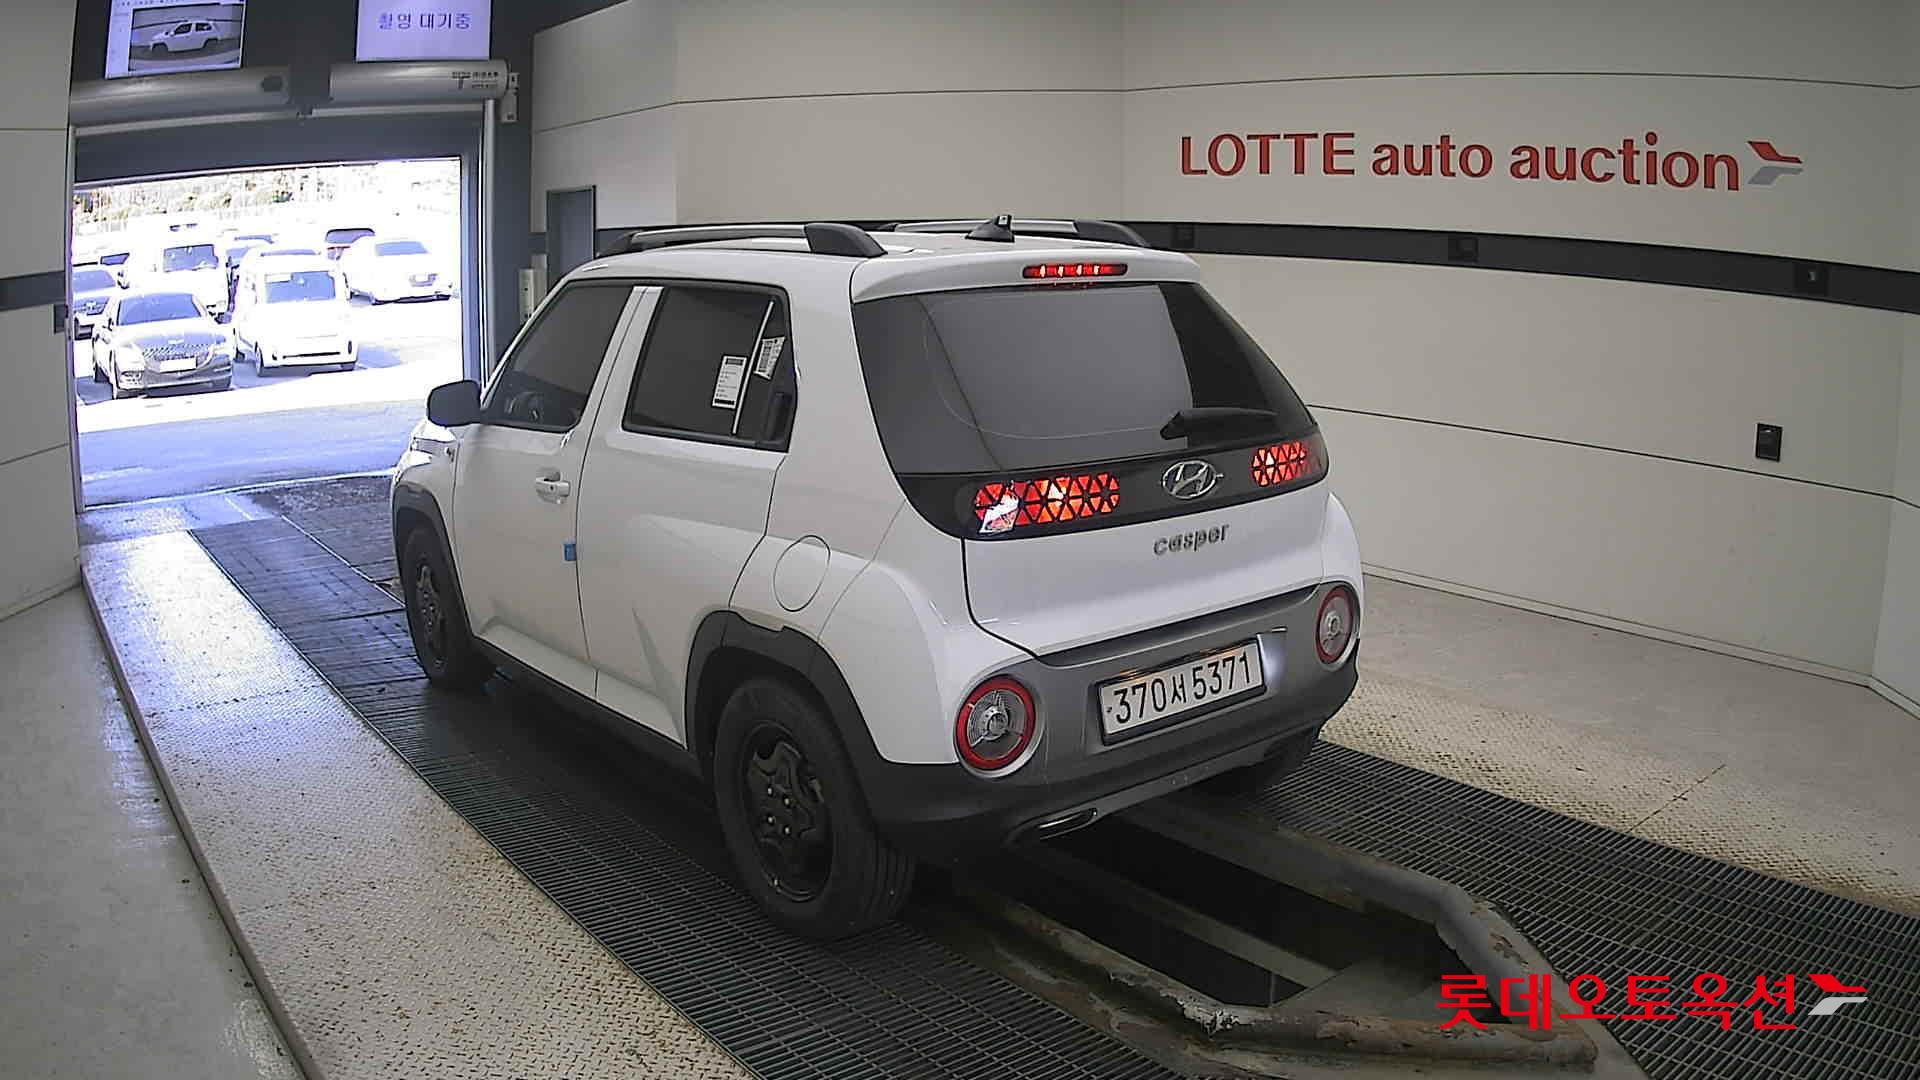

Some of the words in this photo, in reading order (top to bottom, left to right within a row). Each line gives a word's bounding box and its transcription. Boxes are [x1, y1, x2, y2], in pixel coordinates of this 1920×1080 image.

[419, 12, 471, 30] 대기중
[1181, 132, 1355, 177] LOTTE
[1372, 136, 1493, 178] auto
[1510, 132, 1740, 191] auction
